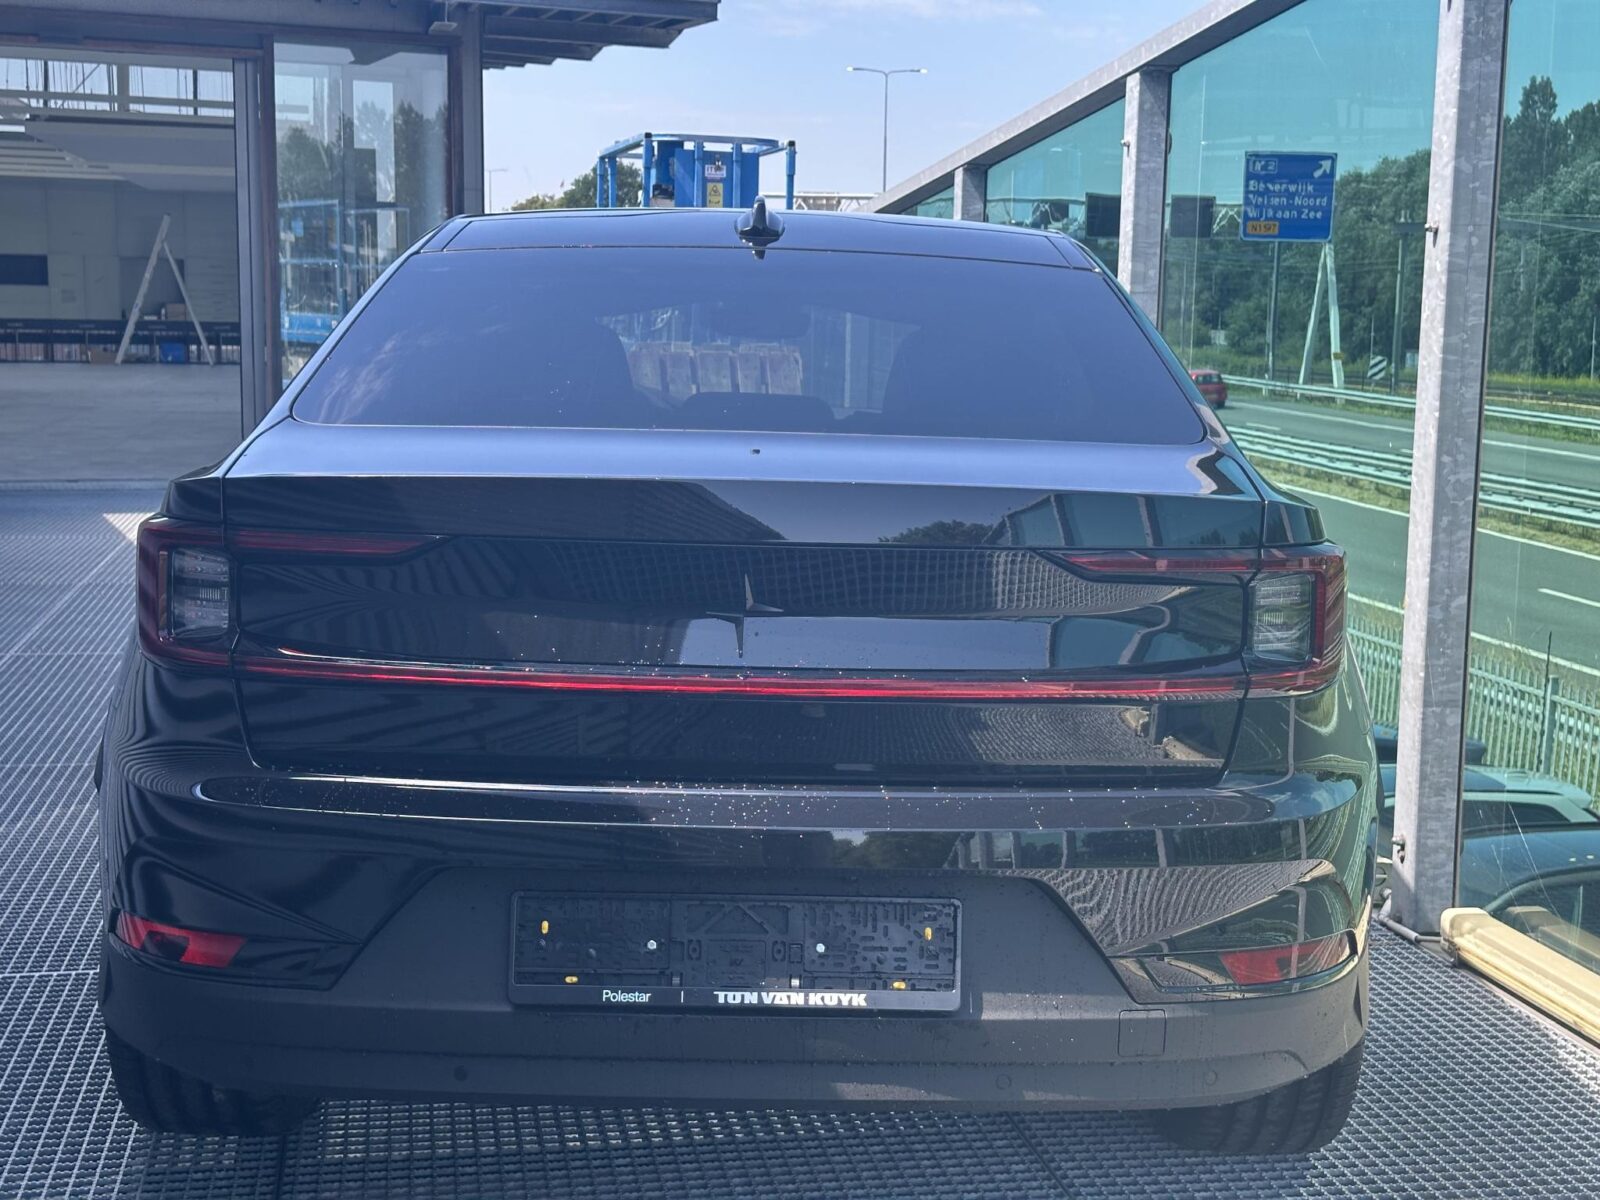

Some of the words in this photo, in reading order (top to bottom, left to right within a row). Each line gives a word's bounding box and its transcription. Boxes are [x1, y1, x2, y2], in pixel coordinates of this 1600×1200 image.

[1248, 180, 1314, 195] Beverwijk
[1247, 206, 1274, 220] Wijk
[1275, 210, 1298, 219] aan
[1300, 208, 1323, 219] Zee
[1250, 222, 1277, 233] N197
[602, 989, 652, 1003] Polestar
[713, 991, 759, 1004] TON
[761, 991, 805, 1006] VAN
[808, 992, 868, 1007] KUYK
